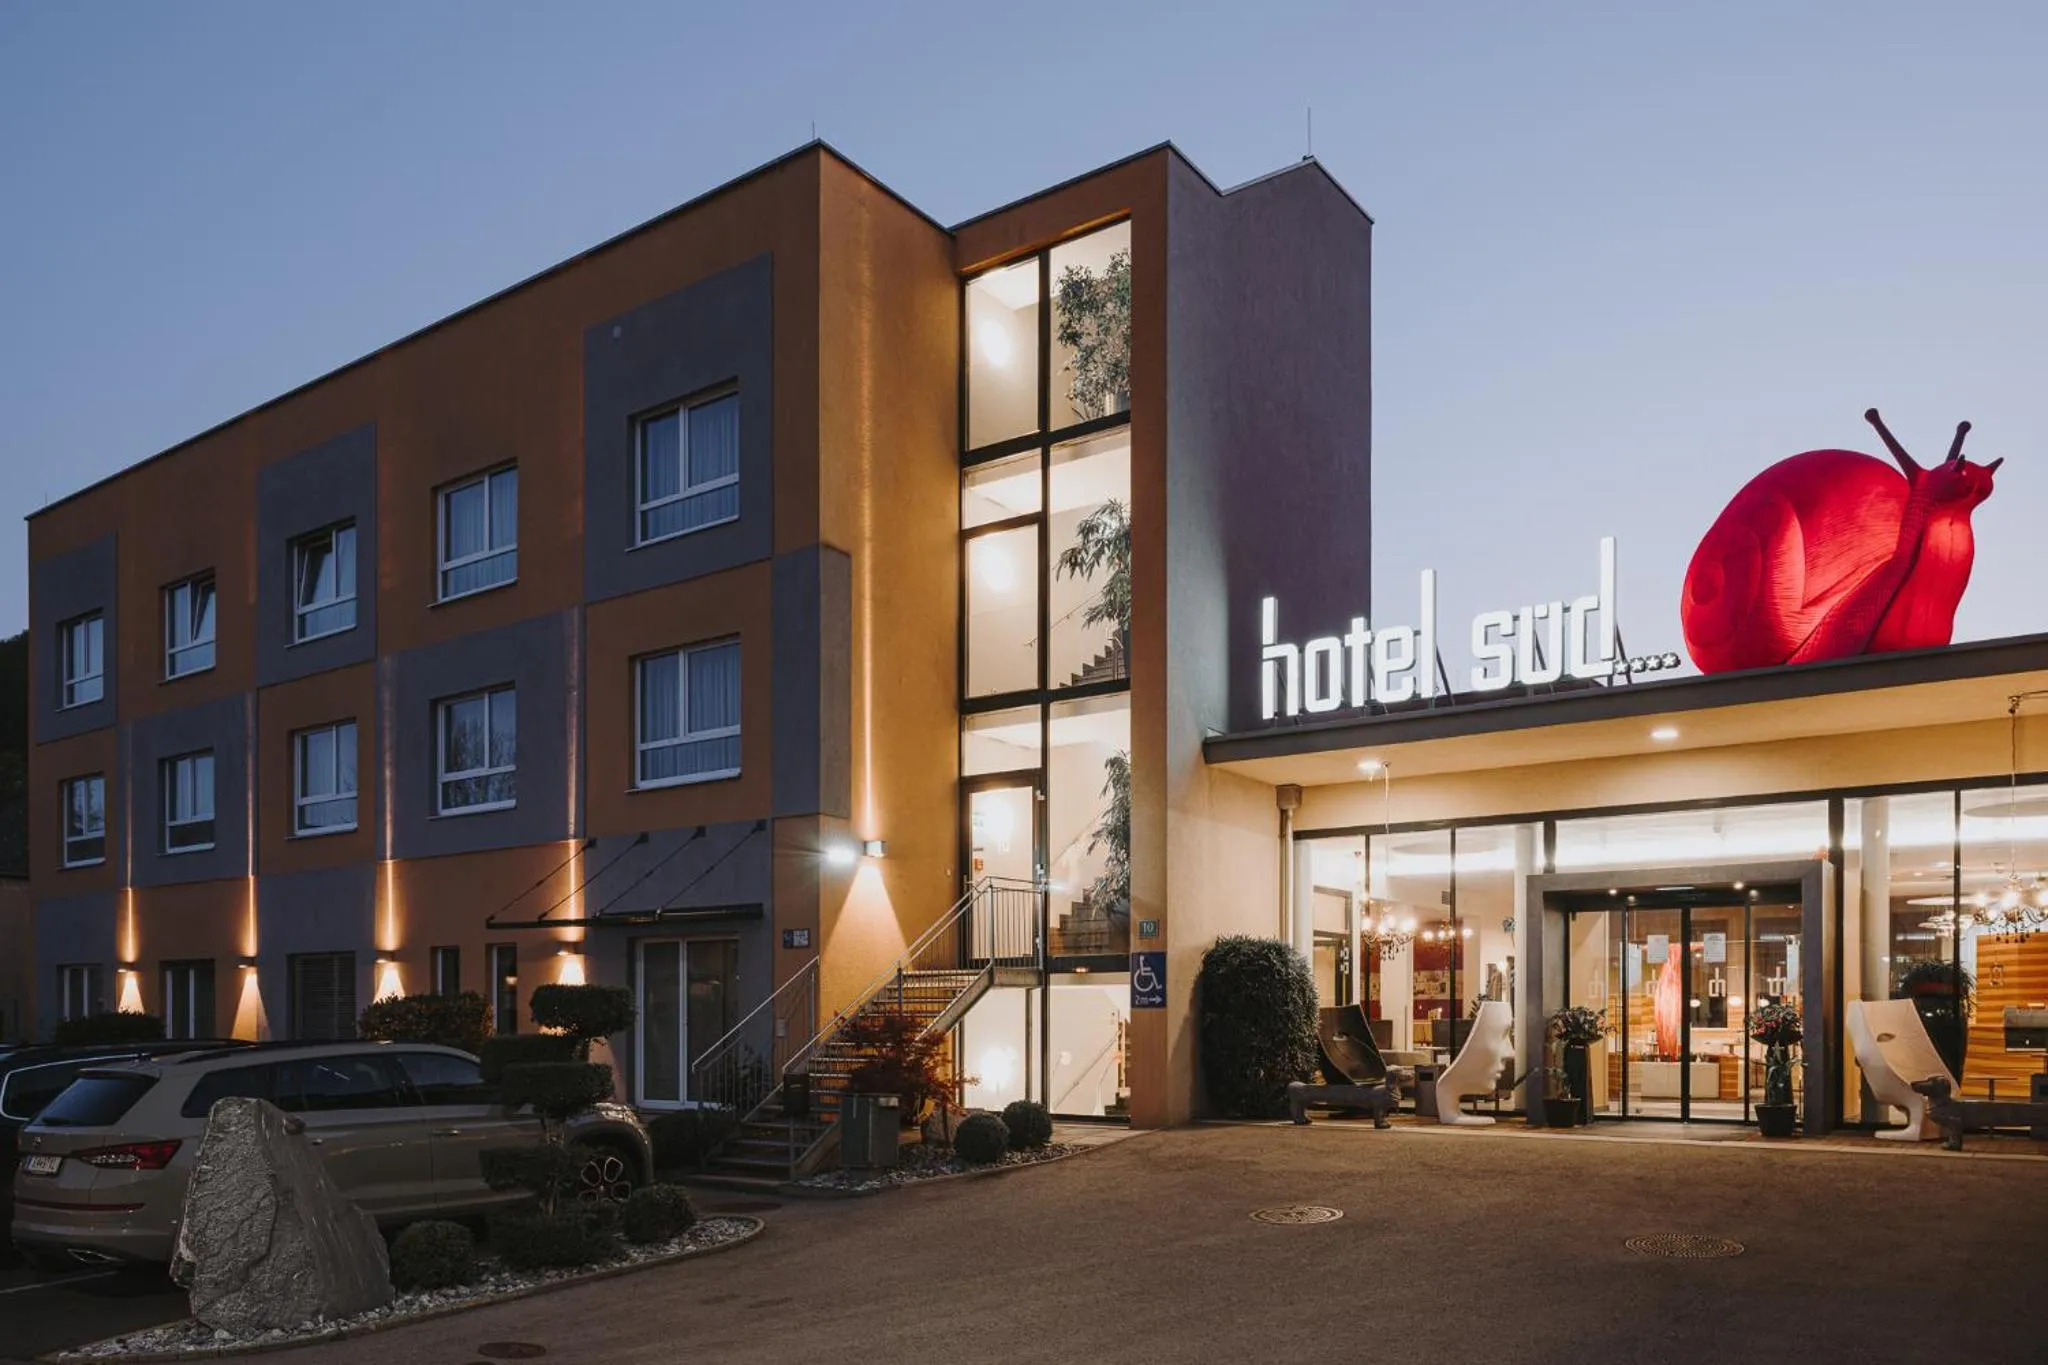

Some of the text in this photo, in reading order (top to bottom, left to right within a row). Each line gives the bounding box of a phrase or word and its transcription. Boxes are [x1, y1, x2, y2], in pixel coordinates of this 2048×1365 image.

[1261, 536, 1616, 720] hotel süd
[1143, 922, 1154, 933] 10
